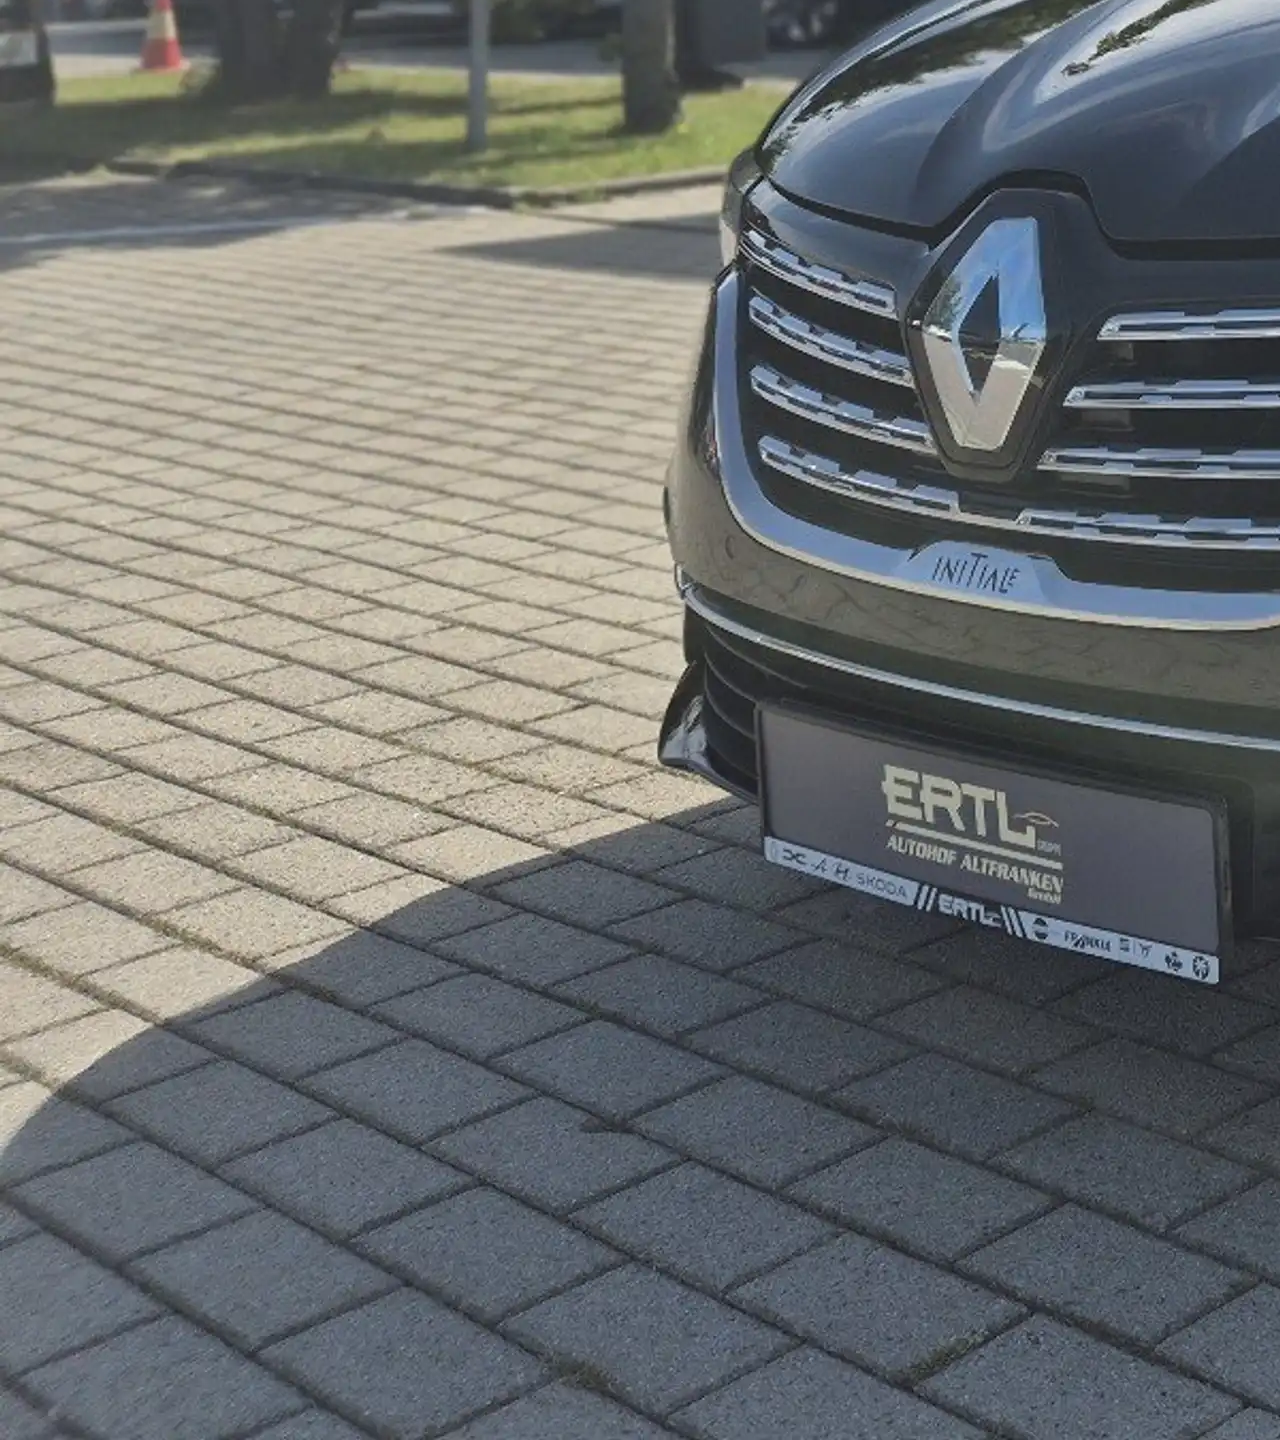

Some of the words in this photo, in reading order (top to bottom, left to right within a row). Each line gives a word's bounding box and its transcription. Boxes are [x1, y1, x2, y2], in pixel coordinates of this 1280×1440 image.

[931, 551, 1021, 594] INITIALE
[881, 763, 1036, 850] ERTL
[884, 834, 958, 866] AUTOHOF
[959, 853, 1064, 894] ALTFRANKEN
[938, 893, 1003, 929] ERTL
